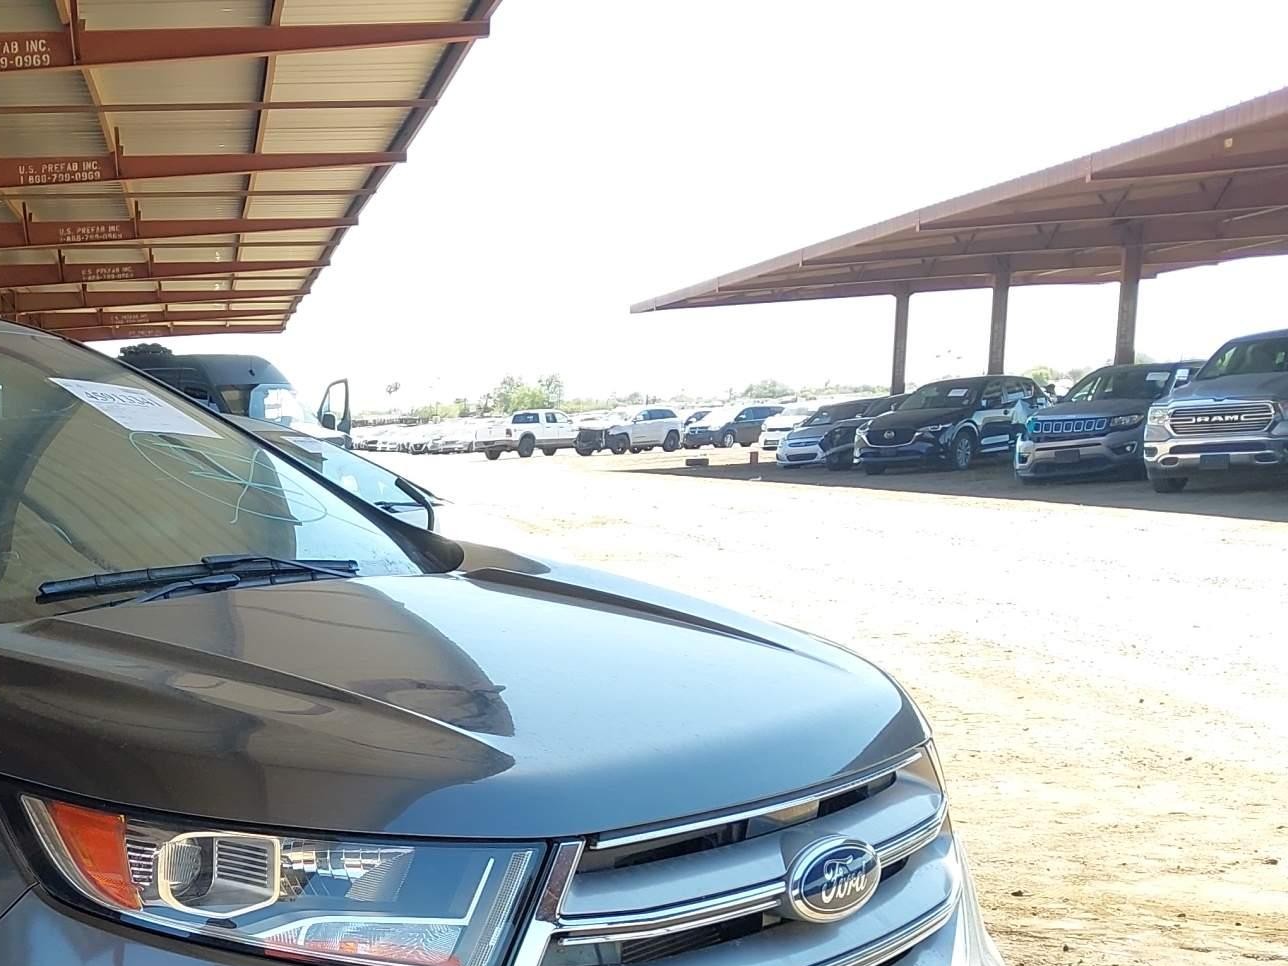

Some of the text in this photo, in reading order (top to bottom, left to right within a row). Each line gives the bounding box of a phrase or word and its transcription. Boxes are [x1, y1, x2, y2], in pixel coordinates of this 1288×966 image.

[25, 39, 51, 53] INC.
[41, 161, 79, 174] PREFAB
[1196, 414, 1239, 423] RAM
[820, 854, 868, 904] Ford
